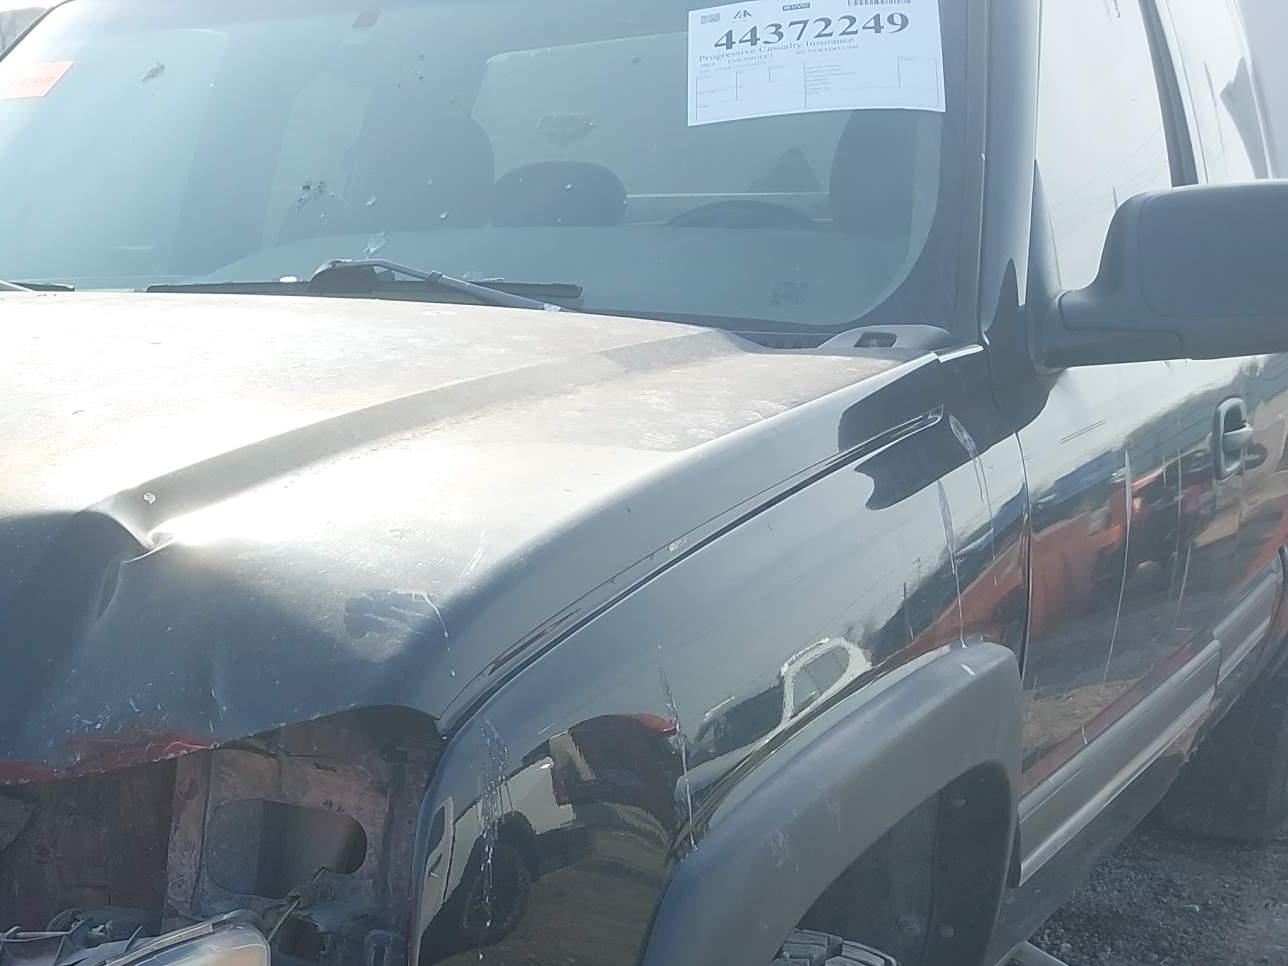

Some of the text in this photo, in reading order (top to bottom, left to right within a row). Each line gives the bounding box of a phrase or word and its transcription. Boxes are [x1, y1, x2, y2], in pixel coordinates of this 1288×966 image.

[713, 12, 909, 50] 44372249
[699, 47, 754, 62] Progressive
[758, 41, 801, 53] Casualty
[806, 38, 854, 48] Insurance
